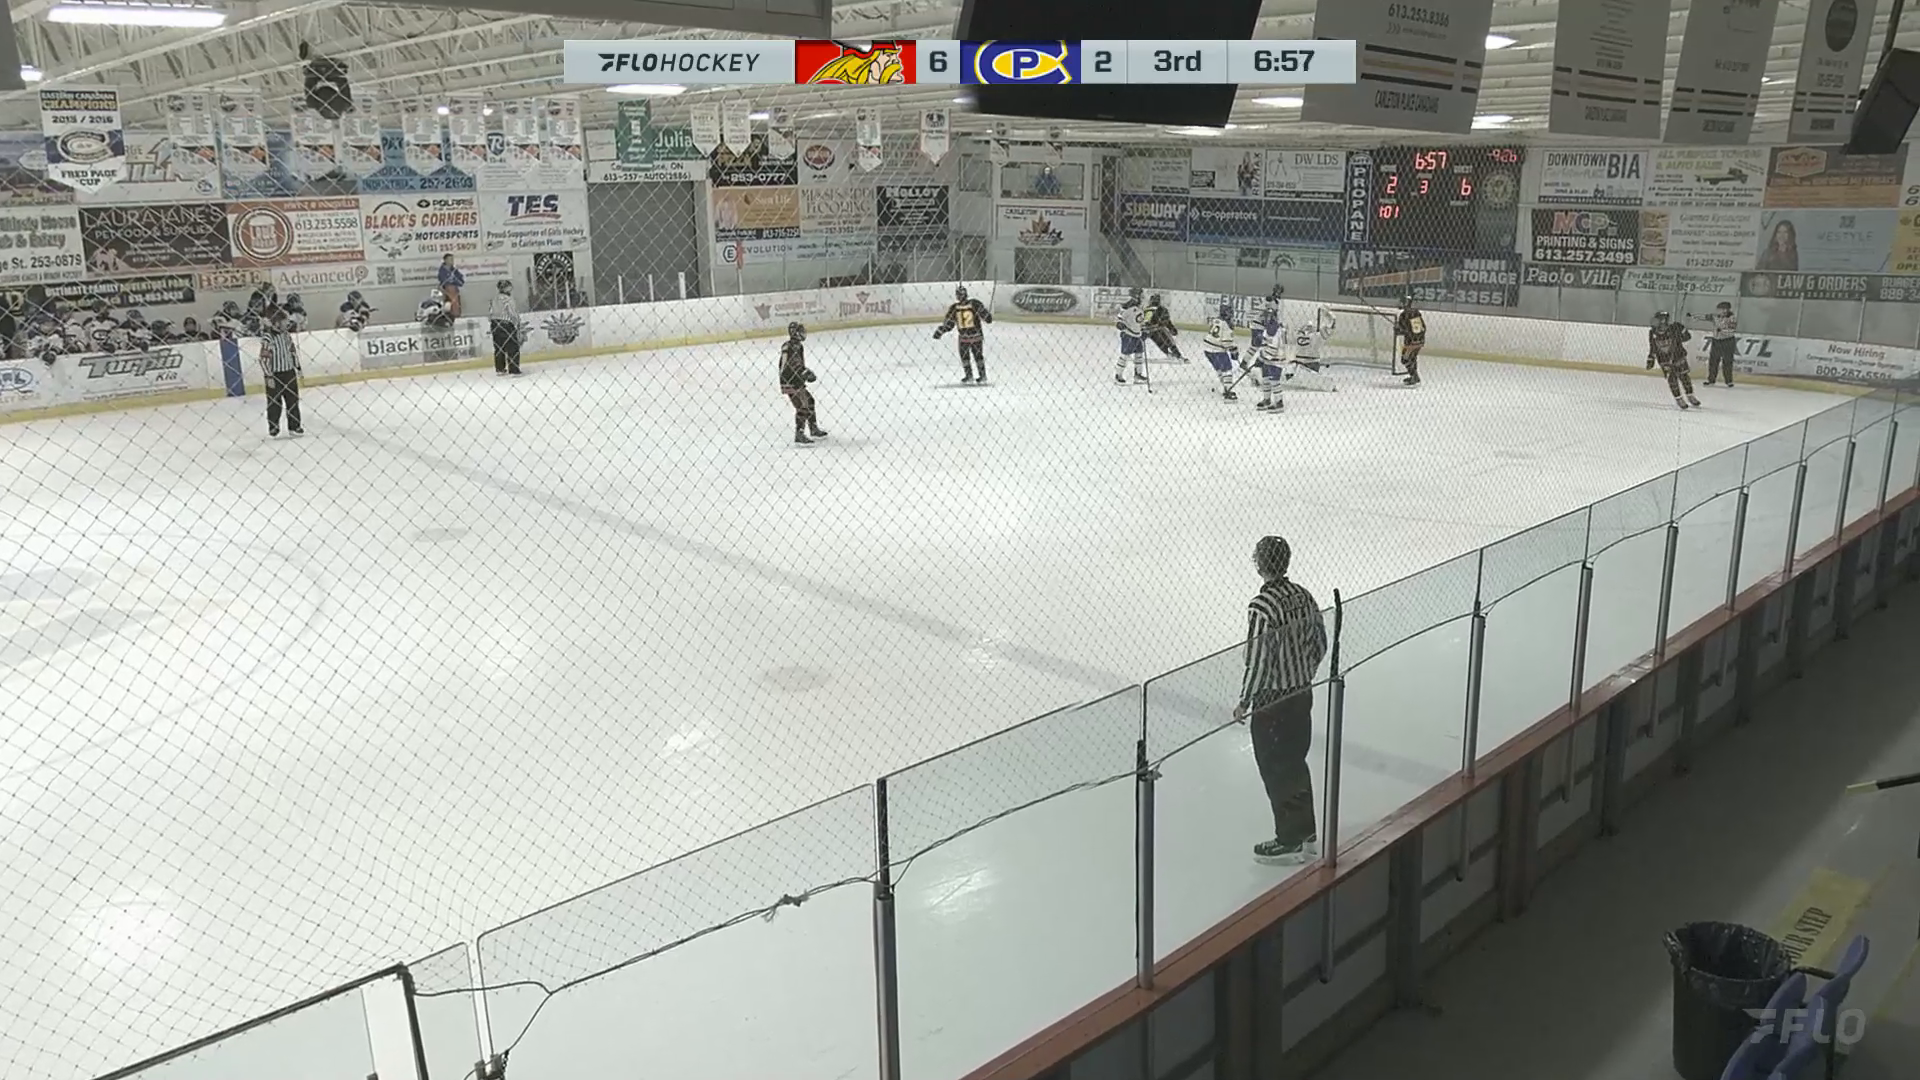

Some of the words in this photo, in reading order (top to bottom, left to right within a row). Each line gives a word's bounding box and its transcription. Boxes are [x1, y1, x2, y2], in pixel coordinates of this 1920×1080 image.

[75, 92, 115, 100] CANADIAN
[42, 99, 117, 110] CHAMPIONS
[52, 116, 77, 124] 2015
[89, 115, 113, 123] 2016
[1295, 153, 1314, 165] DW
[1317, 153, 1339, 166] LDS
[1547, 152, 1607, 167] DOWNTOWN
[1607, 153, 1641, 179] BIA
[61, 170, 88, 179] FRED
[91, 169, 118, 178] PAGE
[79, 178, 101, 187] CUP
[1386, 175, 1398, 194] 2
[1420, 179, 1429, 194] 3
[508, 194, 559, 216] TES
[1124, 202, 1186, 219] SUBWAY
[1350, 166, 1366, 241] PROPANE
[84, 208, 157, 228] LAURA
[365, 214, 417, 230] BLACK'S
[421, 212, 478, 228] CORNERS
[1201, 209, 1258, 220] co-operators
[415, 230, 479, 241] MOTORSPORTS
[1536, 235, 1587, 248] PRINTING
[1588, 237, 1597, 248] &
[1599, 237, 1634, 250] SIGNS
[30, 253, 83, 269] 253-0879
[1464, 258, 1506, 270] MINI
[1535, 248, 1634, 264] 613.257.3499
[279, 270, 354, 286] Advanced
[1453, 269, 1518, 285] STORAGE
[1526, 267, 1574, 284] Paolo
[1581, 269, 1621, 286] Villa
[1777, 274, 1805, 290] LAW
[1817, 275, 1868, 291] ORDERS
[1413, 286, 1504, 305] 257-3355
[367, 337, 418, 355] black
[424, 334, 474, 350] tartan
[1828, 344, 1849, 355] Now
[1853, 345, 1886, 360] Hiring
[79, 349, 183, 378] Turpin
[156, 371, 178, 382] Kia
[1794, 906, 1833, 936] STEP
